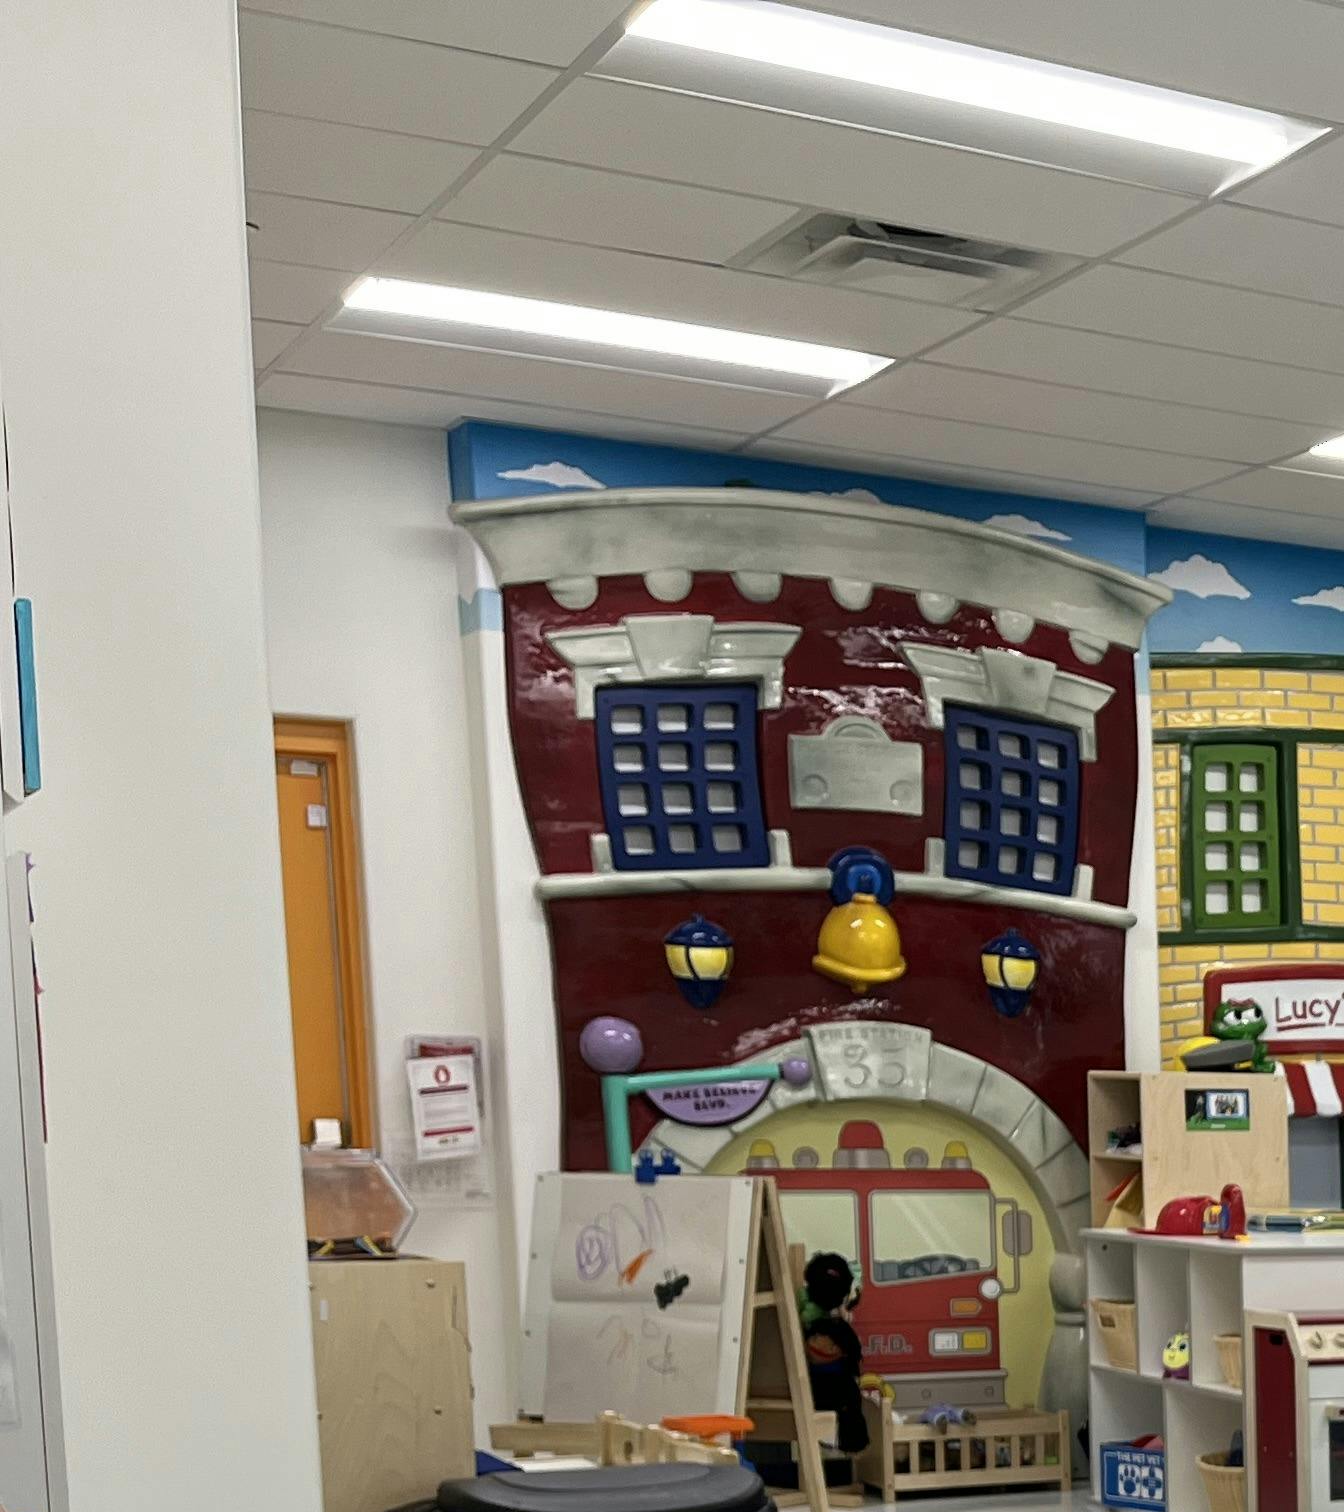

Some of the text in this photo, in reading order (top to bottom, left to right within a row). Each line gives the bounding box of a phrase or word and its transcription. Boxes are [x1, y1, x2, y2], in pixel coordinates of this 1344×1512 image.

[817, 1028, 853, 1042] FIRE
[662, 1087, 700, 1100] MAKE
[862, 1334, 913, 1355] .F.D.
